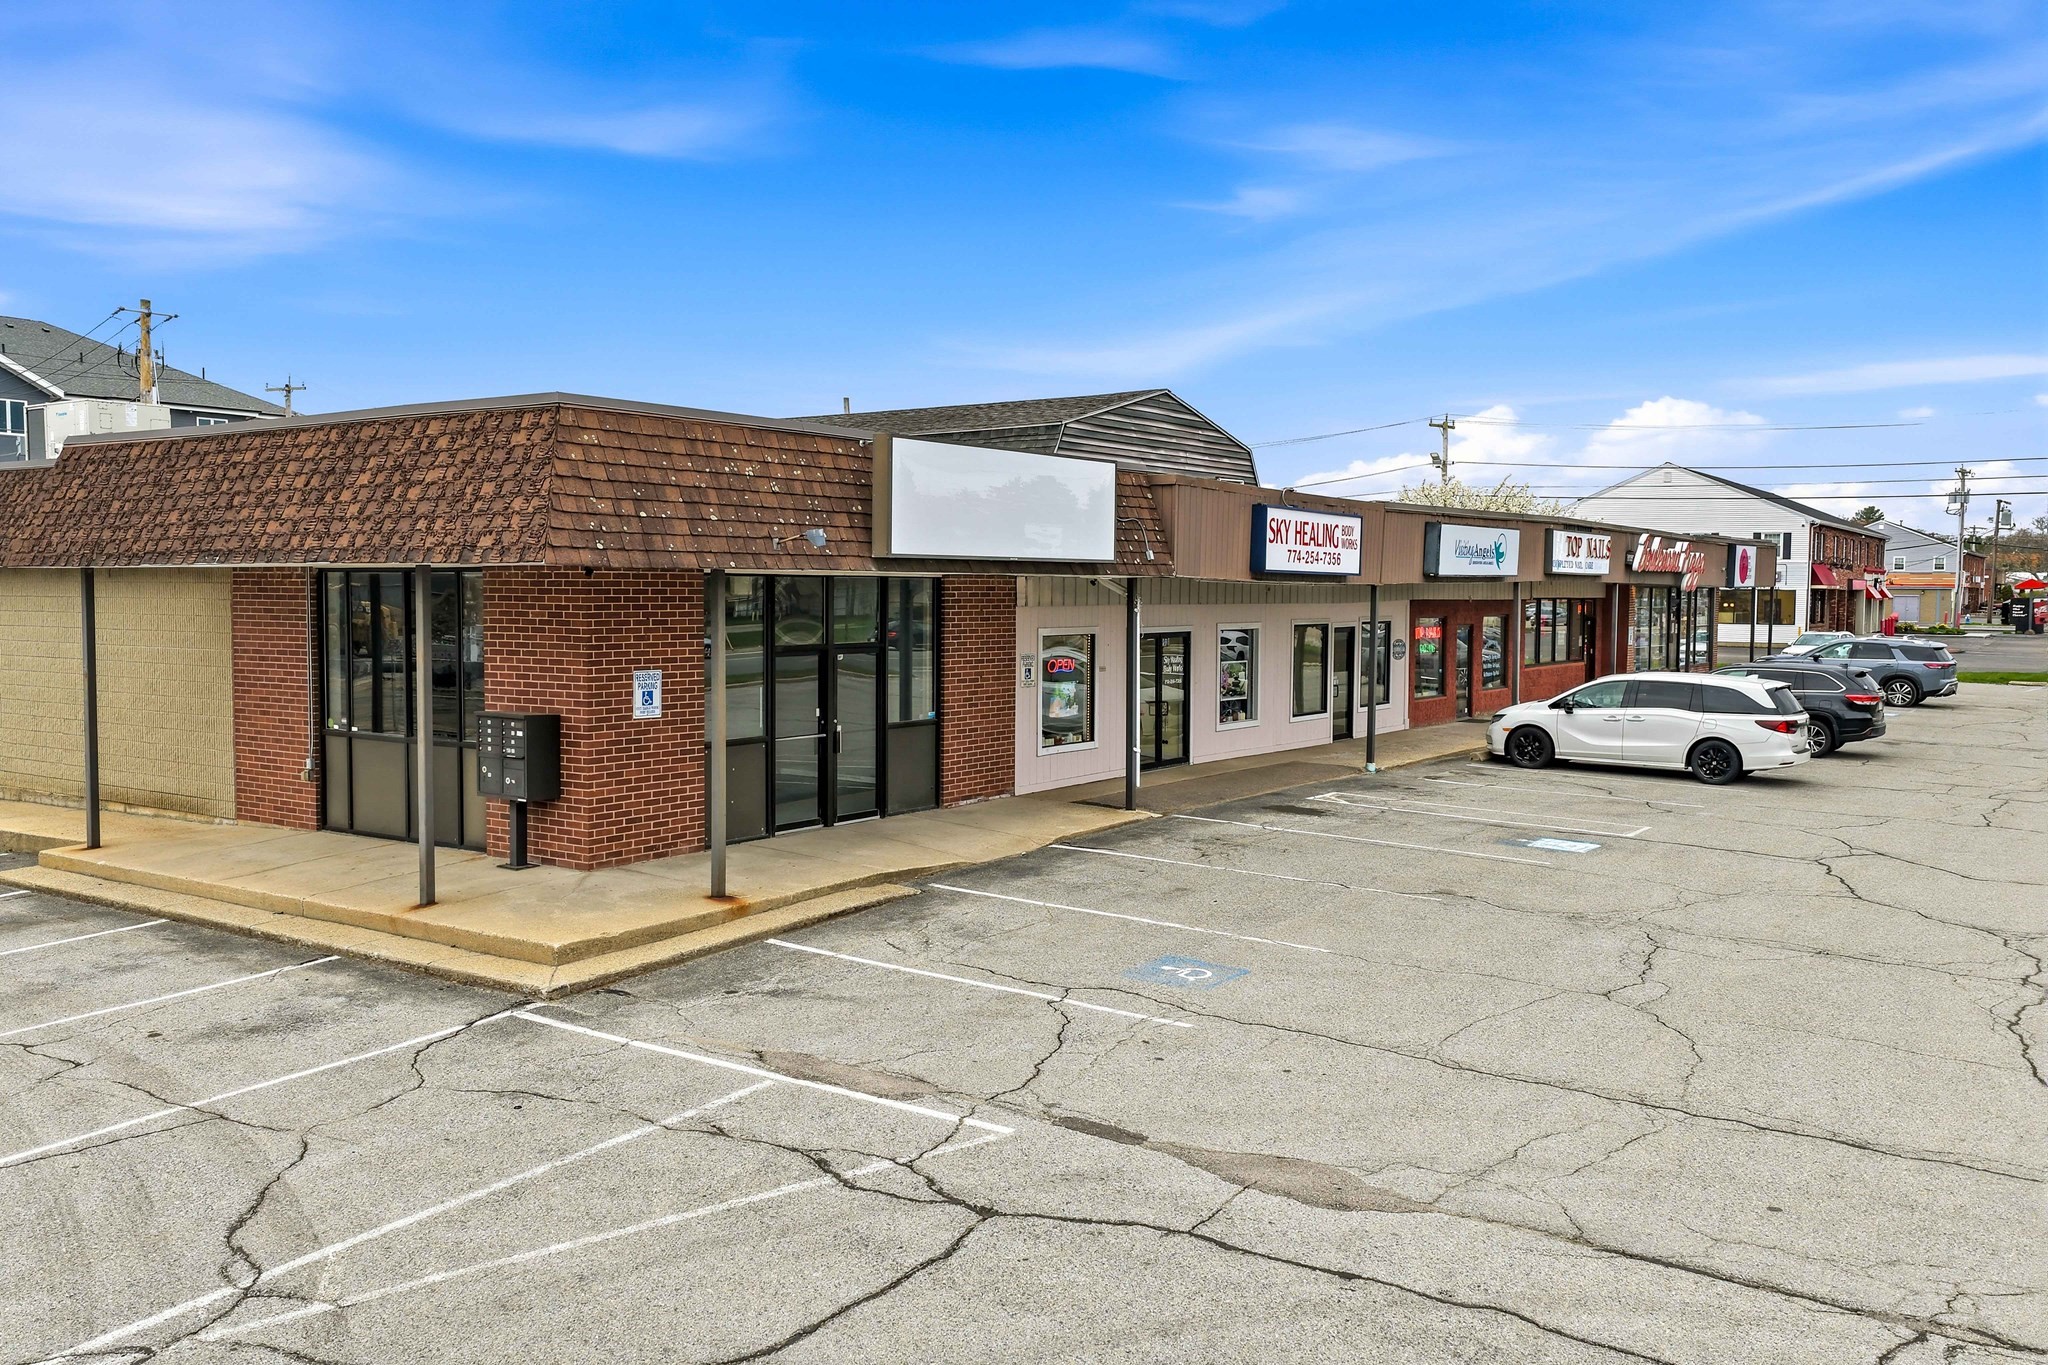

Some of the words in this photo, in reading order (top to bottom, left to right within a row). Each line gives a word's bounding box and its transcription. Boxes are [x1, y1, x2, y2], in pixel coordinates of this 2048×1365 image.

[1268, 517, 1291, 544] SKY
[1294, 520, 1339, 549] HEALING
[1341, 525, 1355, 537] BODY
[1341, 538, 1358, 550] WORKS
[1566, 535, 1583, 558] TOP
[1586, 538, 1612, 560] NAILS
[1287, 549, 1342, 566] 774-254-7356
[1473, 544, 1496, 560] Angels
[1047, 659, 1075, 673] OPEN
[635, 673, 660, 682] RESERVED
[637, 681, 658, 690] PARKING
